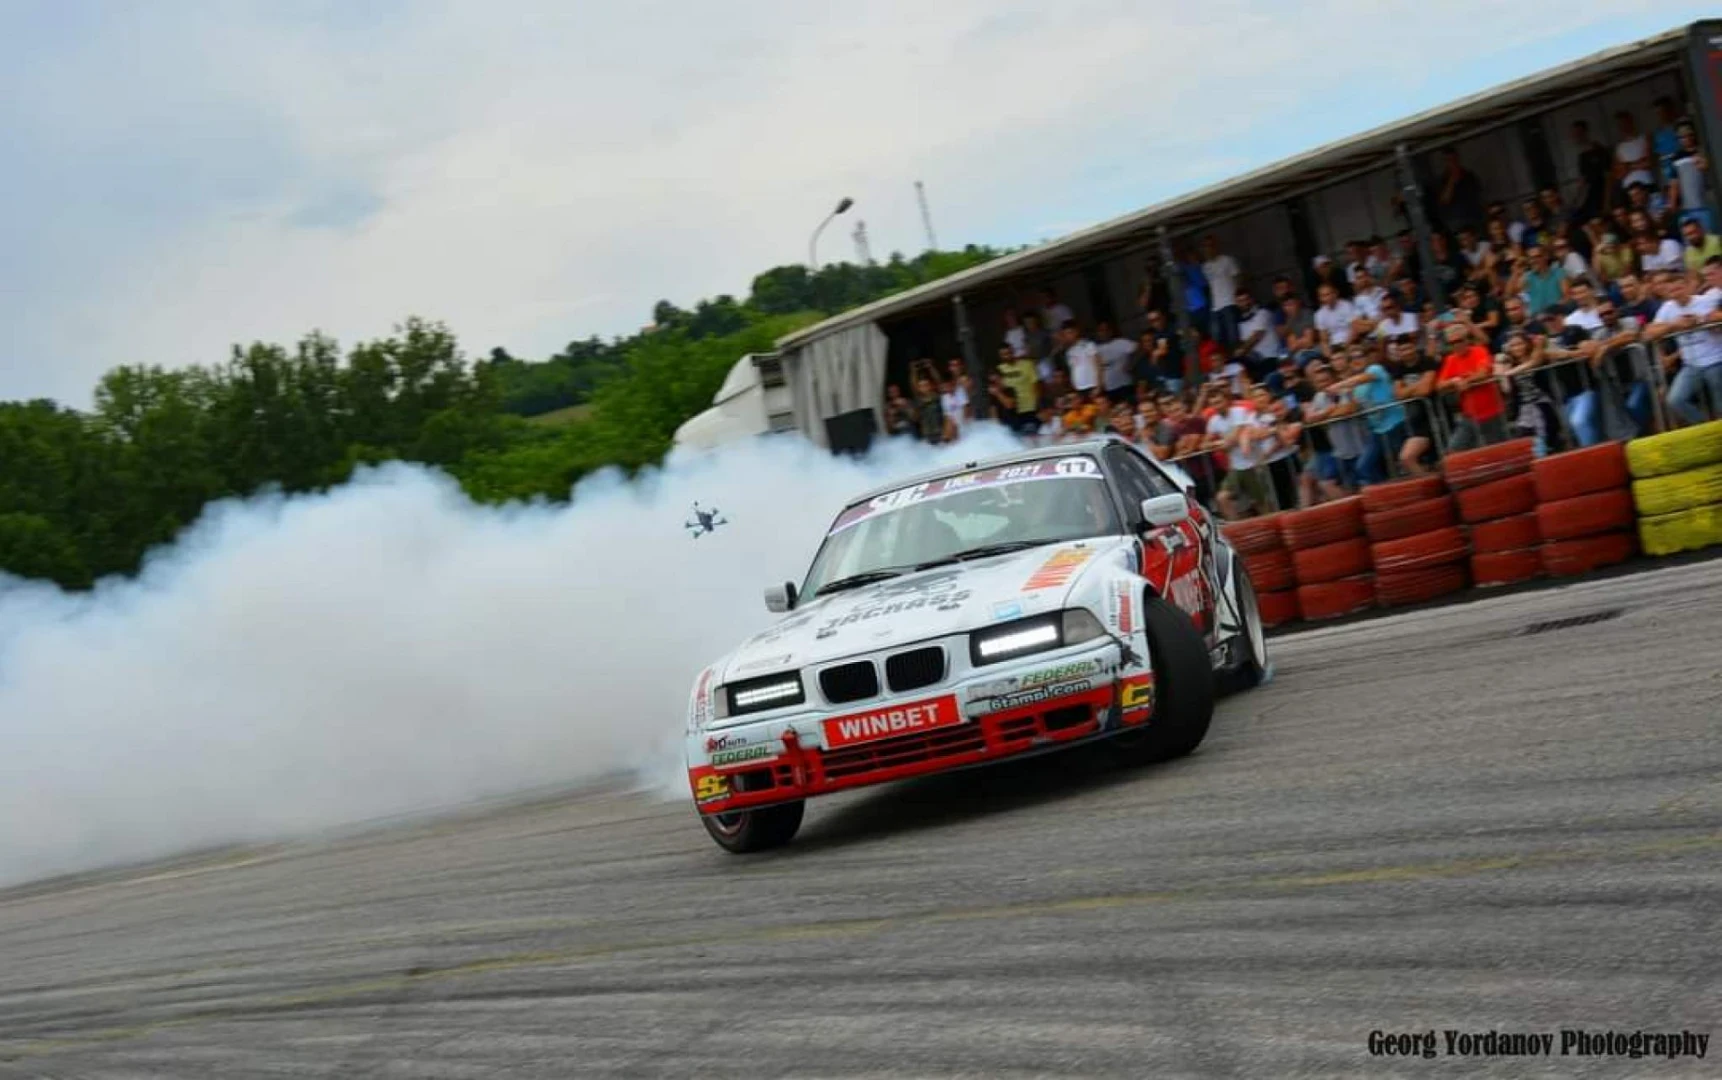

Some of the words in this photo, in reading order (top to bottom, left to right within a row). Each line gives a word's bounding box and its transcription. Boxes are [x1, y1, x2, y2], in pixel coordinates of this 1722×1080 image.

[1021, 660, 1096, 685] FEDERAL
[838, 703, 939, 739] WINBET
[712, 744, 771, 766] FEDERAL
